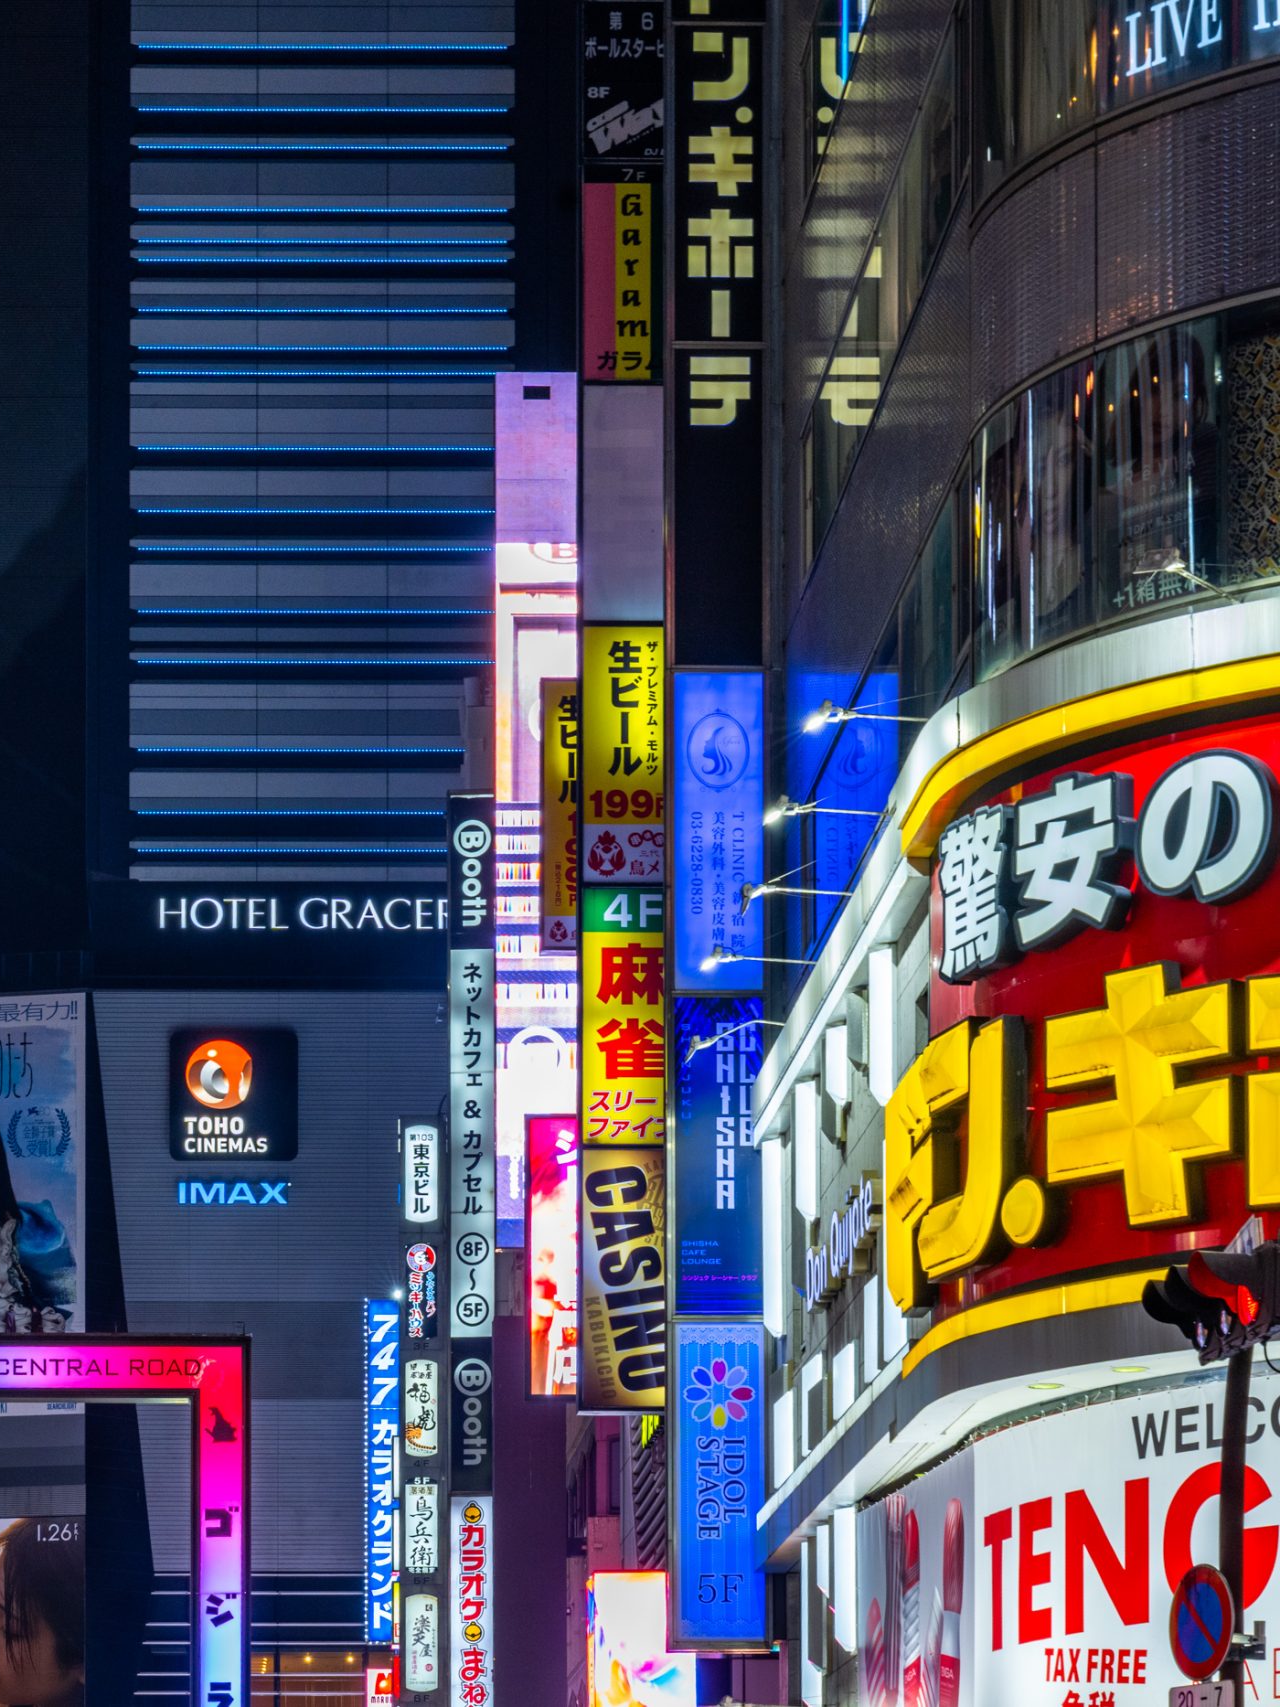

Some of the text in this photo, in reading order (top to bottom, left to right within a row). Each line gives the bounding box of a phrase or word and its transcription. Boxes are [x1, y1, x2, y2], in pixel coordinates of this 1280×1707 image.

[587, 87, 610, 98] 8F
[622, 168, 646, 182] 7F
[615, 193, 649, 337] Garam
[608, 640, 643, 776] 生ビール
[646, 641, 659, 776] ザ・プレミアム・モルツ
[453, 819, 492, 927] Booth
[690, 811, 703, 915] 03-6228-0830
[732, 828, 745, 883] CLINIC
[159, 898, 288, 929] HOTEL
[603, 894, 663, 928] 4F
[462, 962, 483, 1088] ネットカフェ
[596, 943, 664, 1080] 麻雀
[184, 1116, 245, 1135] TOHO
[409, 1133, 434, 1141] 第103
[589, 1090, 657, 1112] スリー
[184, 1137, 269, 1154] CINEMAS
[413, 1144, 431, 1214] 東京ビル
[462, 1130, 484, 1216] カプセル
[178, 1182, 288, 1205] IMAX
[806, 1174, 873, 1313] Don Quijote
[129, 1358, 201, 1376] ROAD
[586, 1296, 617, 1400] KABUKICHO
[454, 1357, 492, 1467] Booth
[414, 1477, 430, 1485] 5F
[697, 1435, 722, 1540] STAGE
[722, 1436, 746, 1523] IDOL
[37, 1523, 71, 1542] 1.26
[370, 1419, 399, 1629] カラオケランド
[204, 1504, 241, 1707] ゴジラ
[460, 1525, 487, 1622] カラオケ
[698, 1573, 744, 1604] 5F
[1044, 1647, 1148, 1685] TAX FREE
